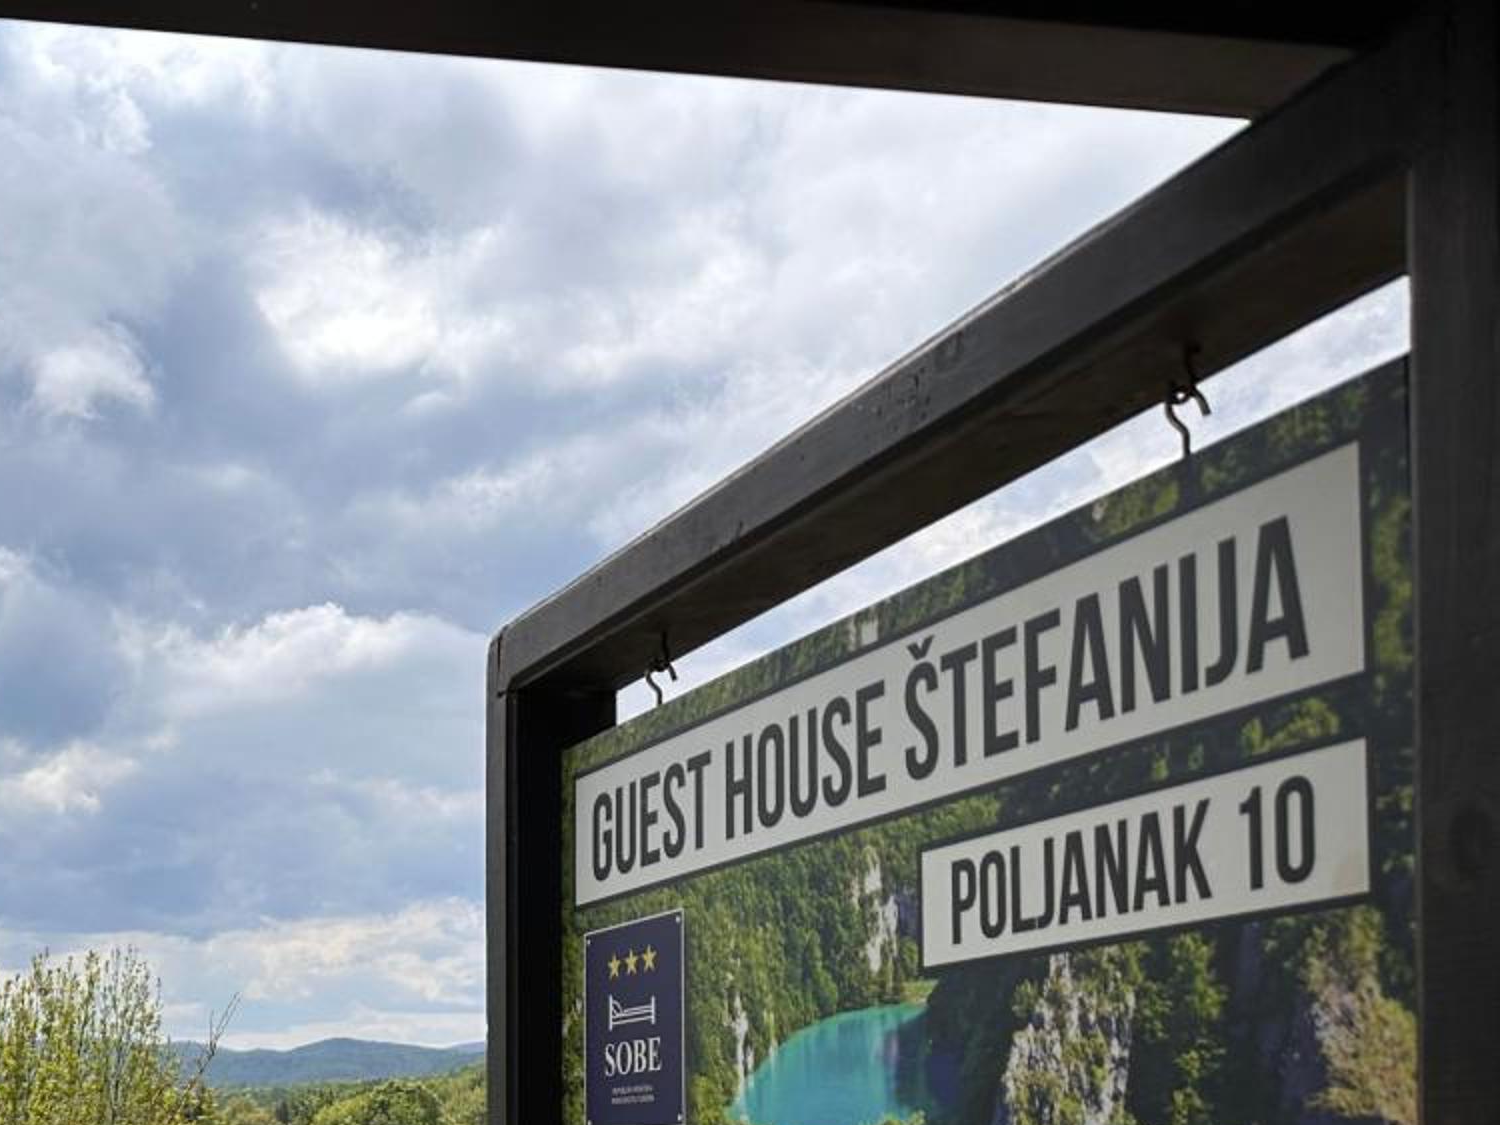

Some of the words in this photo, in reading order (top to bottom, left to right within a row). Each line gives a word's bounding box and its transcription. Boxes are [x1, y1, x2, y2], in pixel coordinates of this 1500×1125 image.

[593, 750, 711, 881] GUEST
[725, 680, 886, 840] HOUSE
[905, 515, 1309, 781] ŠTEFANIJA
[951, 798, 1211, 945] POLJANAK
[1239, 775, 1316, 892] 10
[605, 1036, 661, 1077] SOBE
